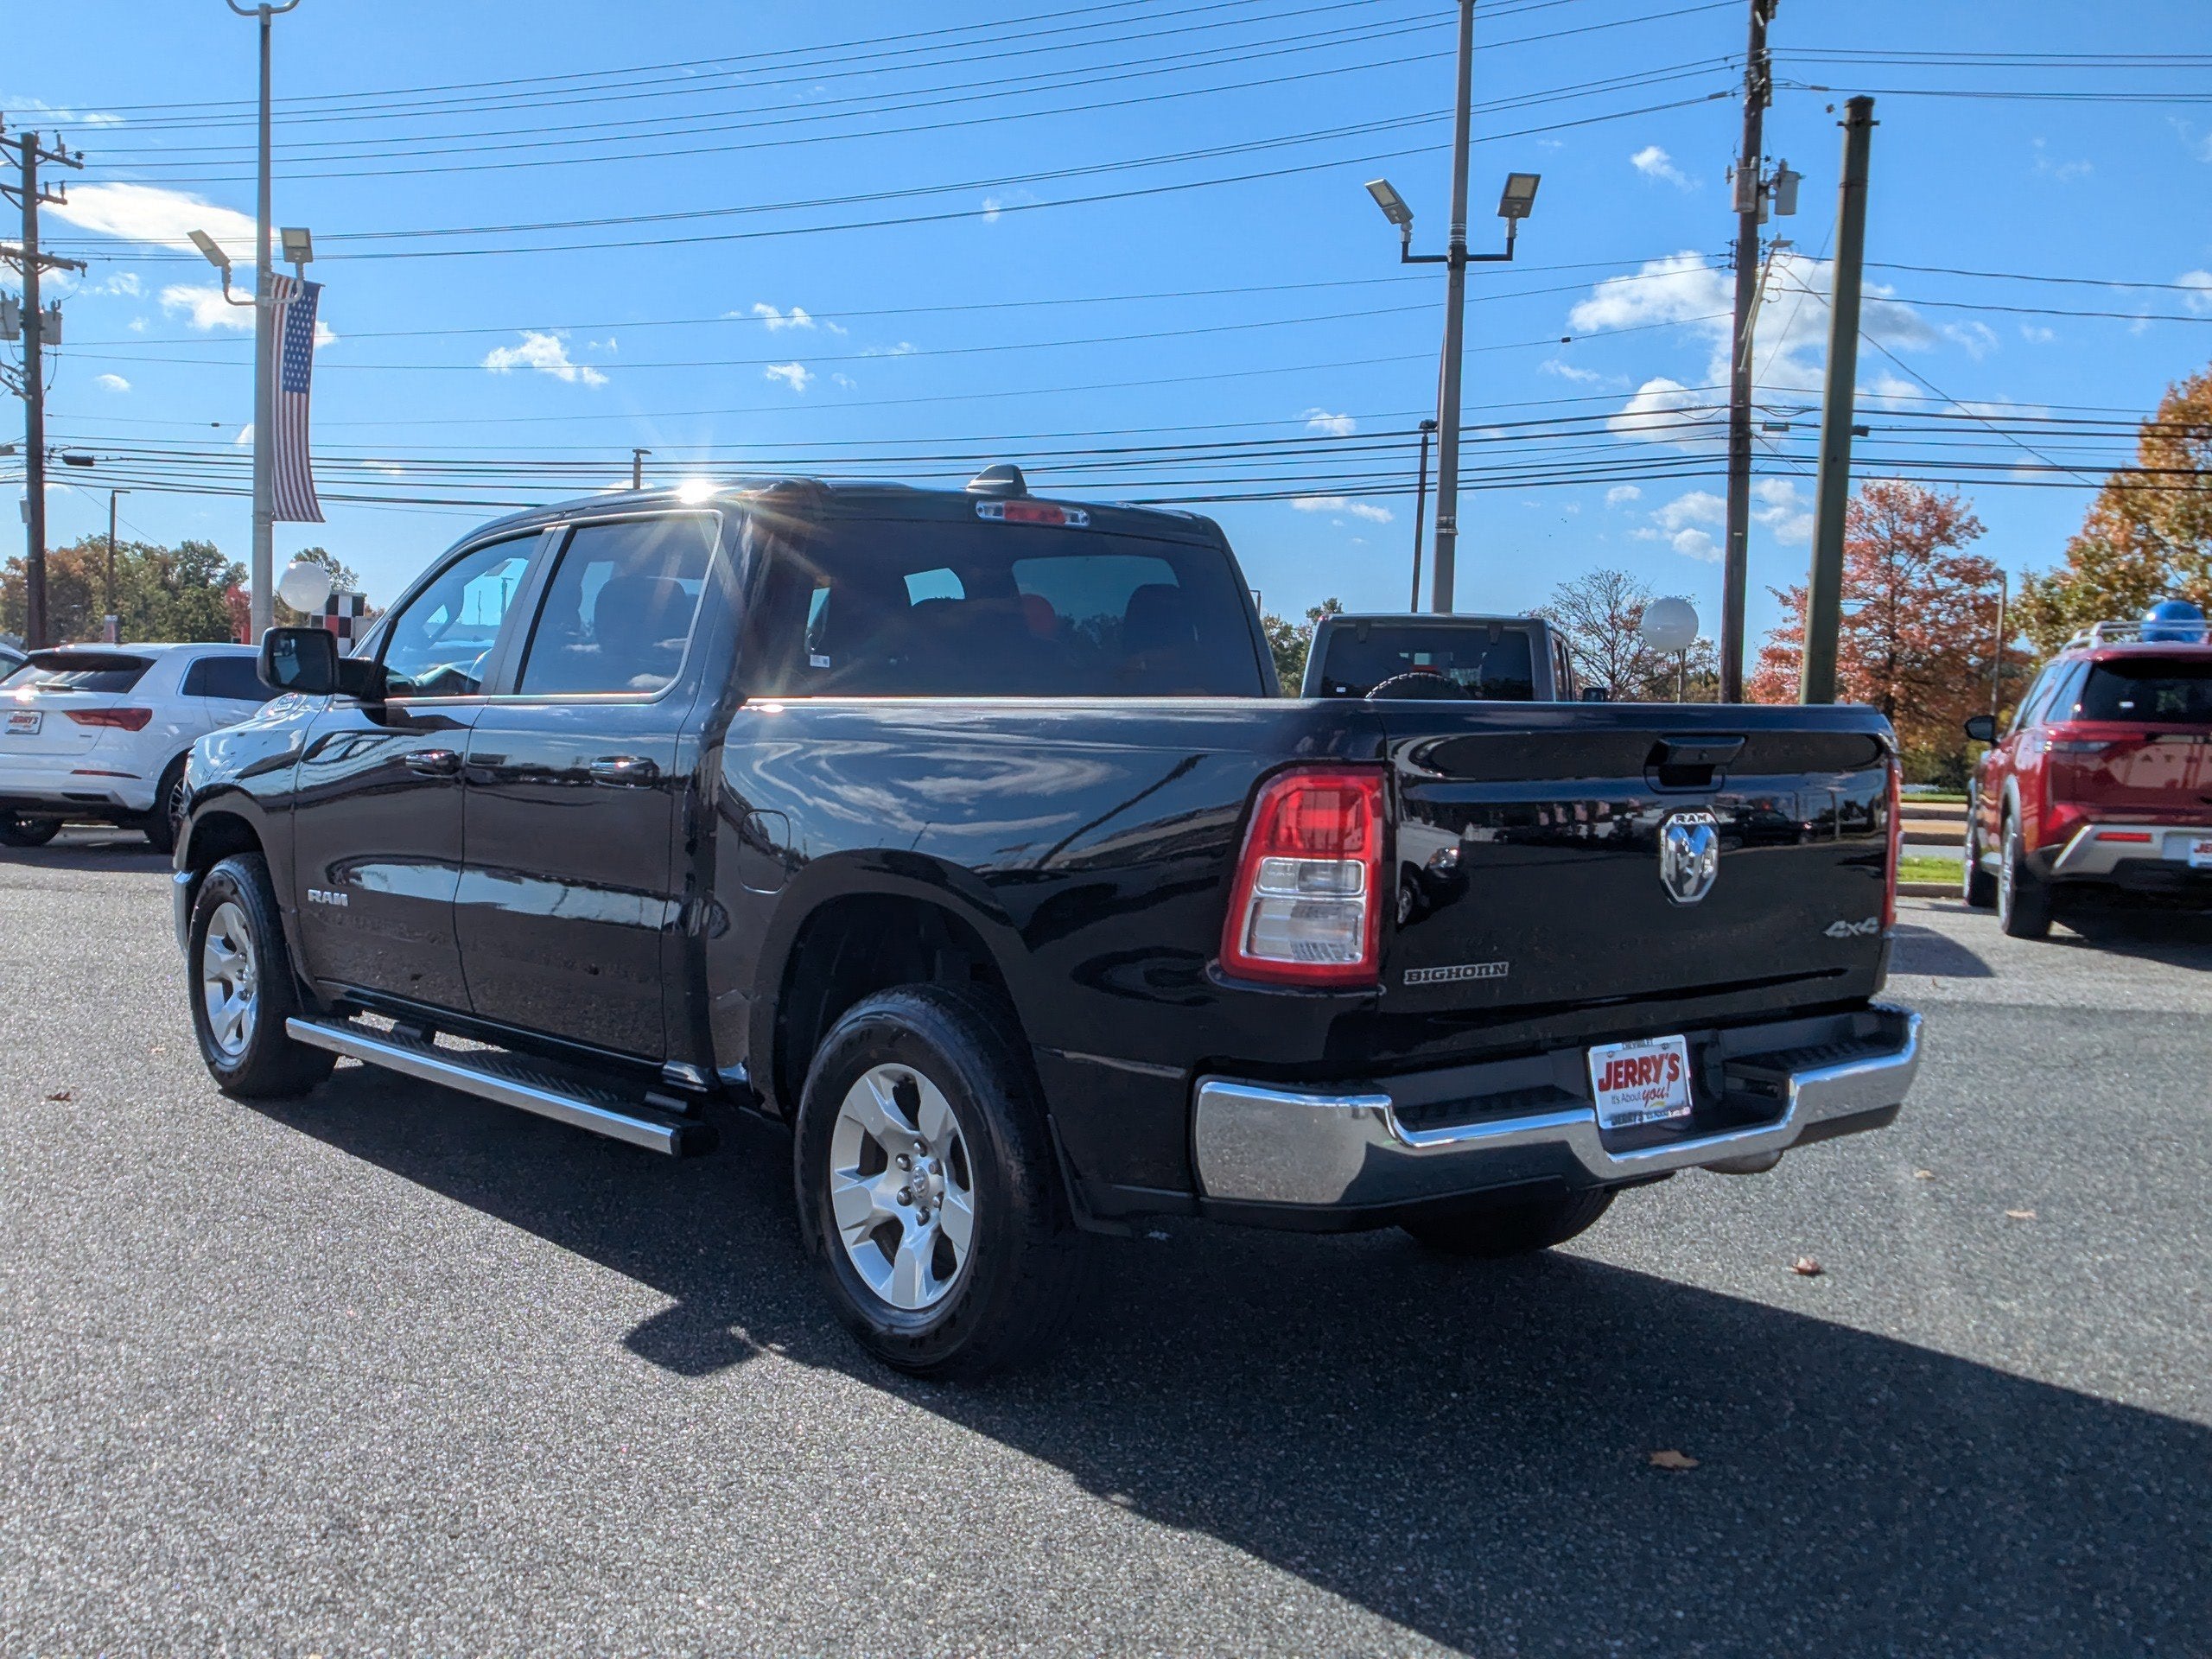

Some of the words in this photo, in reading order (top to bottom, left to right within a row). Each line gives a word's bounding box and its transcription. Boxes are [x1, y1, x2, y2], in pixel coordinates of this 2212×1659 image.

[1675, 814, 1708, 823] RAM
[308, 888, 349, 907] RAM
[1403, 961, 1510, 985] BIGHORN
[1598, 1052, 1681, 1093] JERRY'S
